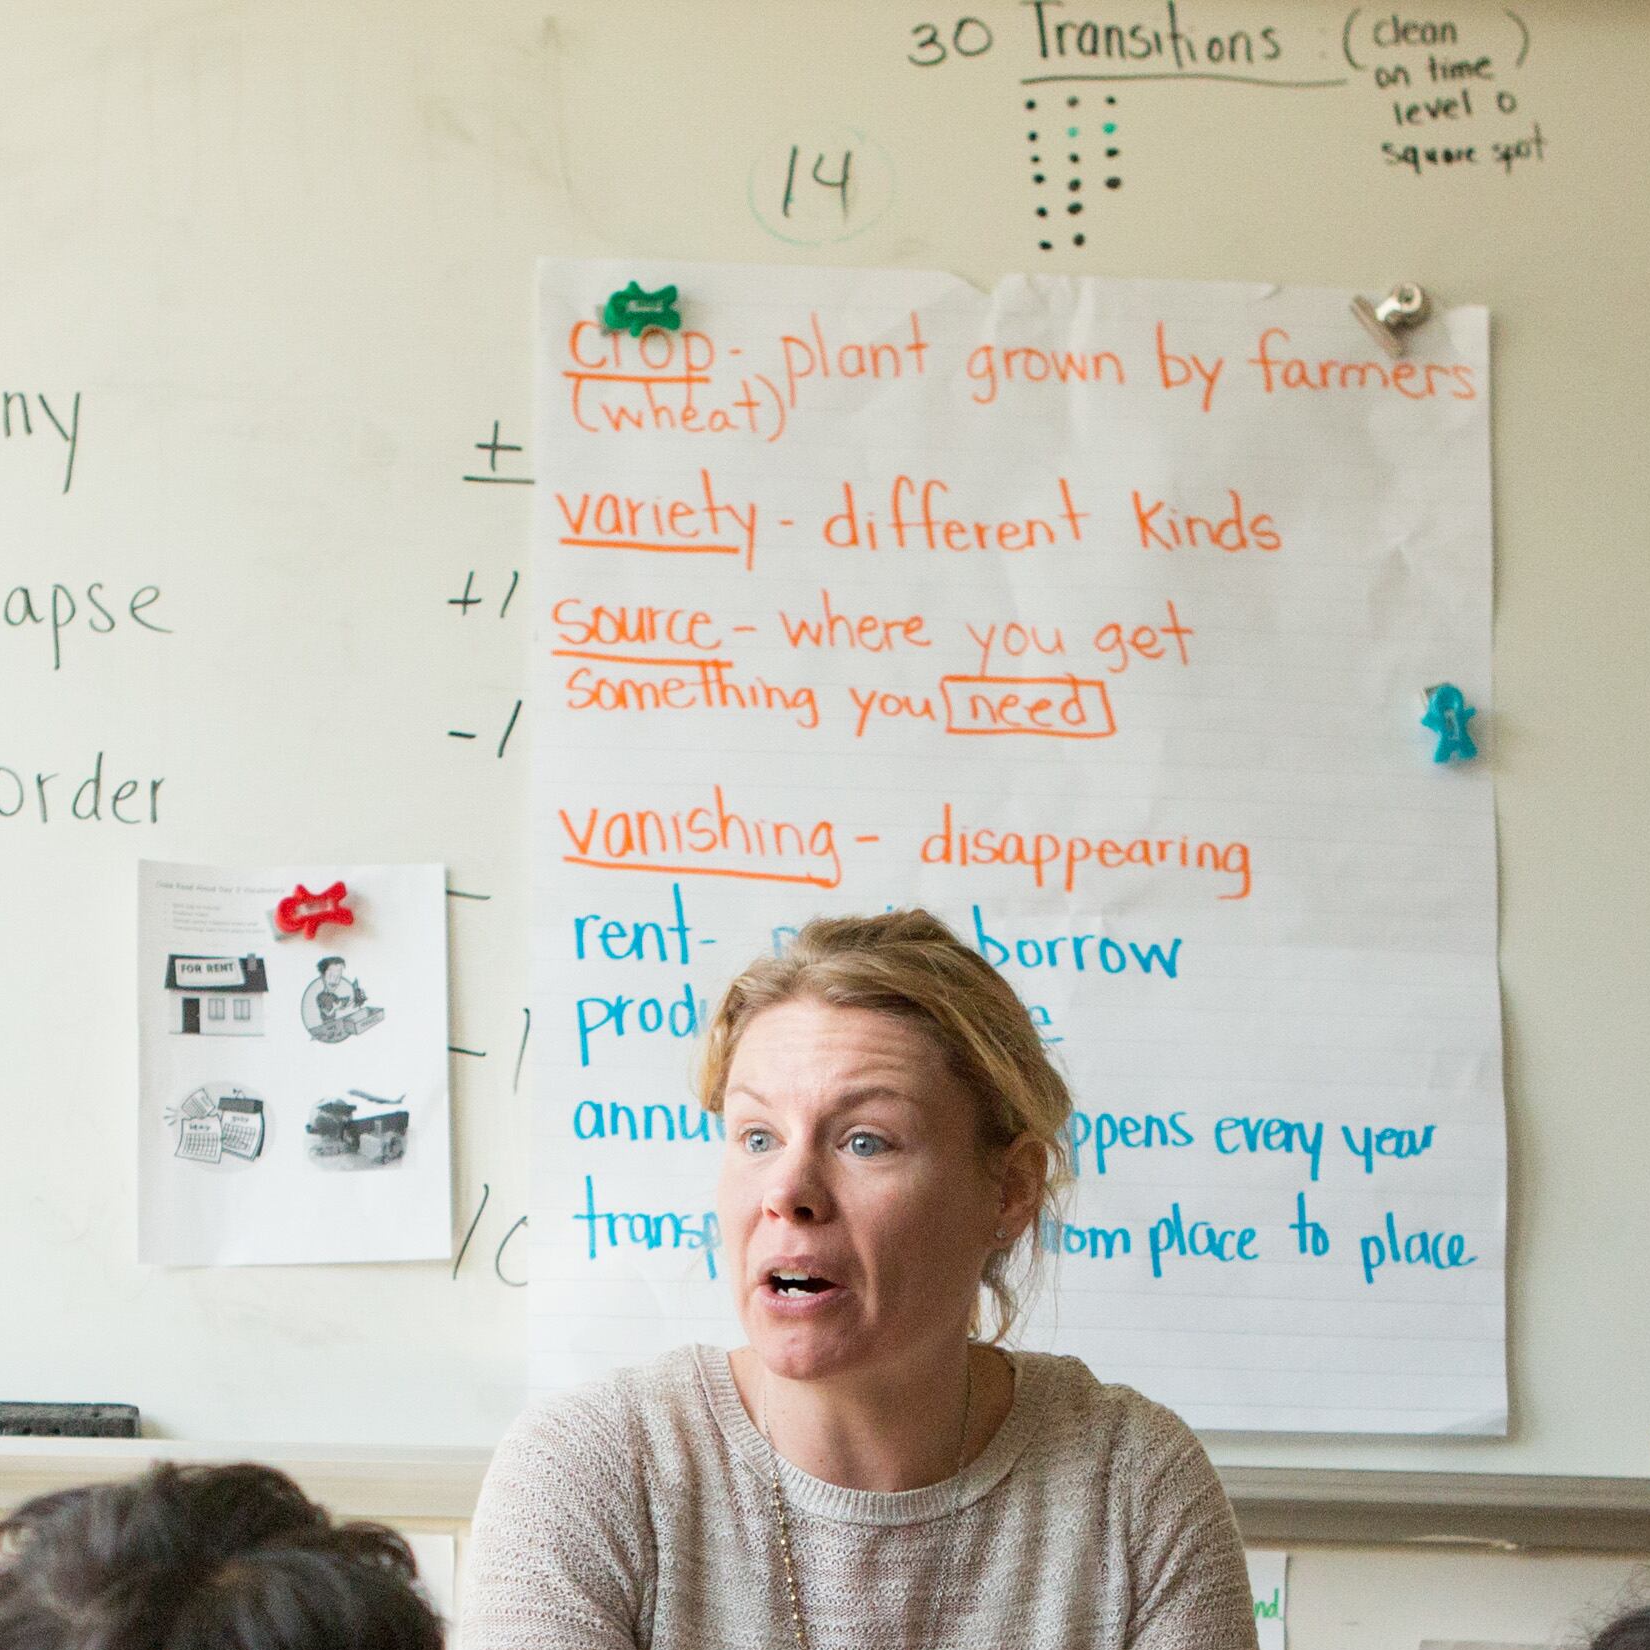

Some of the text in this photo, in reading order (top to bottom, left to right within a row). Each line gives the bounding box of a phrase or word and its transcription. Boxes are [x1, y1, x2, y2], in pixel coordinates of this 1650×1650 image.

[908, 15, 993, 68] 30
[1027, 0, 1284, 66] Transitions
[1374, 53, 1495, 89] on time
[1393, 88, 1472, 125] level
[782, 145, 853, 224] 14
[1381, 122, 1546, 175] square spot
[780, 310, 930, 408] plant
[966, 345, 1126, 405] grown
[1156, 319, 1224, 413] by
[1248, 326, 1477, 400] farmers
[570, 373, 787, 443] (wheat)
[823, 473, 1091, 551] different
[779, 589, 932, 653] where
[966, 622, 1066, 677] you
[1093, 600, 1195, 674] get
[849, 688, 936, 738] you
[969, 674, 1087, 728] need
[919, 803, 1252, 901] disappearing
[180, 960, 235, 975] FOR RENT
[972, 904, 1183, 979] borrow
[576, 983, 708, 1067] prod
[1053, 1110, 1194, 1178] ppens
[1214, 1112, 1324, 1182] every
[1342, 1119, 1438, 1175] year
[572, 1174, 723, 1281] transp
[1149, 1201, 1261, 1279] place
[1289, 1191, 1330, 1258] to
[1359, 1211, 1480, 1286] place
